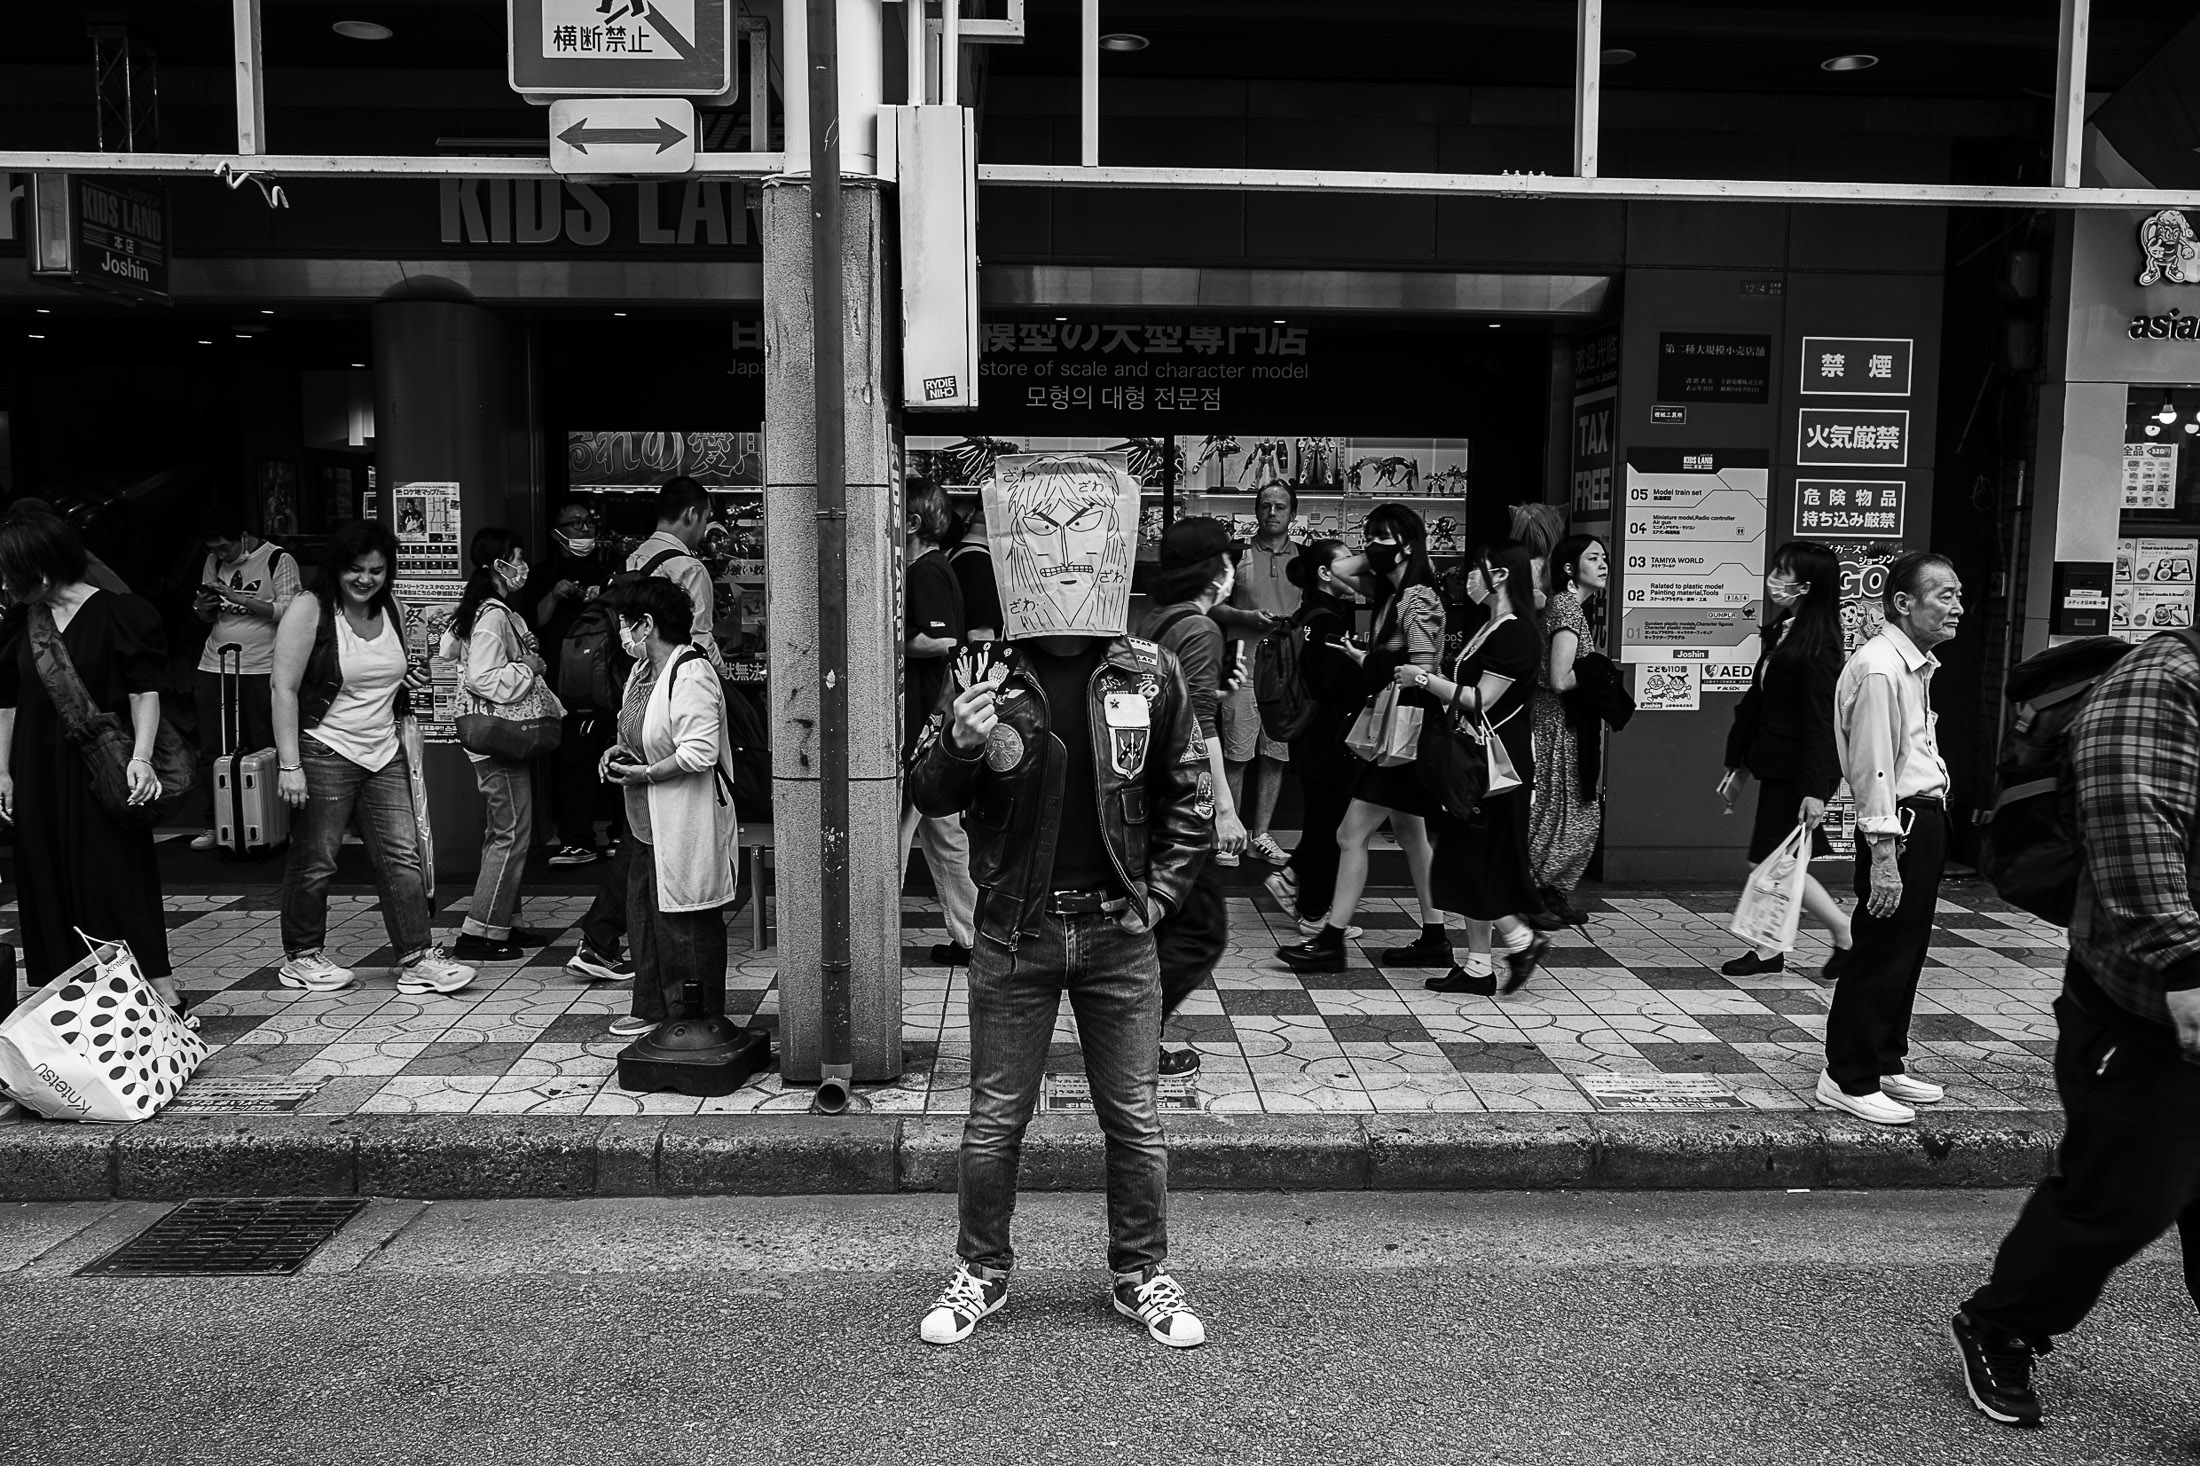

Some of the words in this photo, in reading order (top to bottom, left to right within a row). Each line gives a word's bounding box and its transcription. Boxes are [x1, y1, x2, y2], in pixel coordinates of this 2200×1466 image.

[553, 25, 653, 53] 横断禁止
[81, 184, 120, 229] KIDS
[122, 199, 162, 242] LAND
[637, 176, 763, 246] LAN
[113, 235, 135, 254] 本店
[101, 251, 149, 282] Joshin
[2128, 308, 2200, 340] asia
[979, 361, 1028, 376] store
[1034, 360, 1054, 376] of
[1060, 361, 1108, 376] scale
[1114, 361, 1149, 377] and
[1155, 362, 1245, 378] character
[1251, 363, 1309, 379] model
[1821, 353, 1893, 378] 禁煙
[925, 377, 955, 390] RYDIE
[1026, 385, 1093, 411] 모형의
[1101, 386, 1145, 411] 대형
[1154, 386, 1221, 411] 전문점
[1579, 410, 1610, 456] TAX
[1807, 425, 1900, 450] 火気厳禁
[1683, 456, 1697, 465] KIDS
[1697, 456, 1713, 465] LAND
[2123, 445, 2144, 457] 全品
[1574, 467, 1611, 512] FREE
[1631, 488, 1649, 501] 05
[1653, 488, 1674, 496] Model
[1804, 488, 1897, 507] 危険物品
[1629, 522, 1648, 535] 04
[1802, 510, 1896, 529] 持ち込み厳禁
[1628, 556, 1646, 568] 03
[1858, 554, 1895, 566] ジョーシン
[1627, 589, 1645, 602] 02
[1650, 589, 1676, 597] Painting
[1683, 583, 1704, 591] plastic
[1626, 627, 1641, 640] 01
[1676, 650, 1705, 658] Joshin
[1719, 665, 1752, 677] AED
